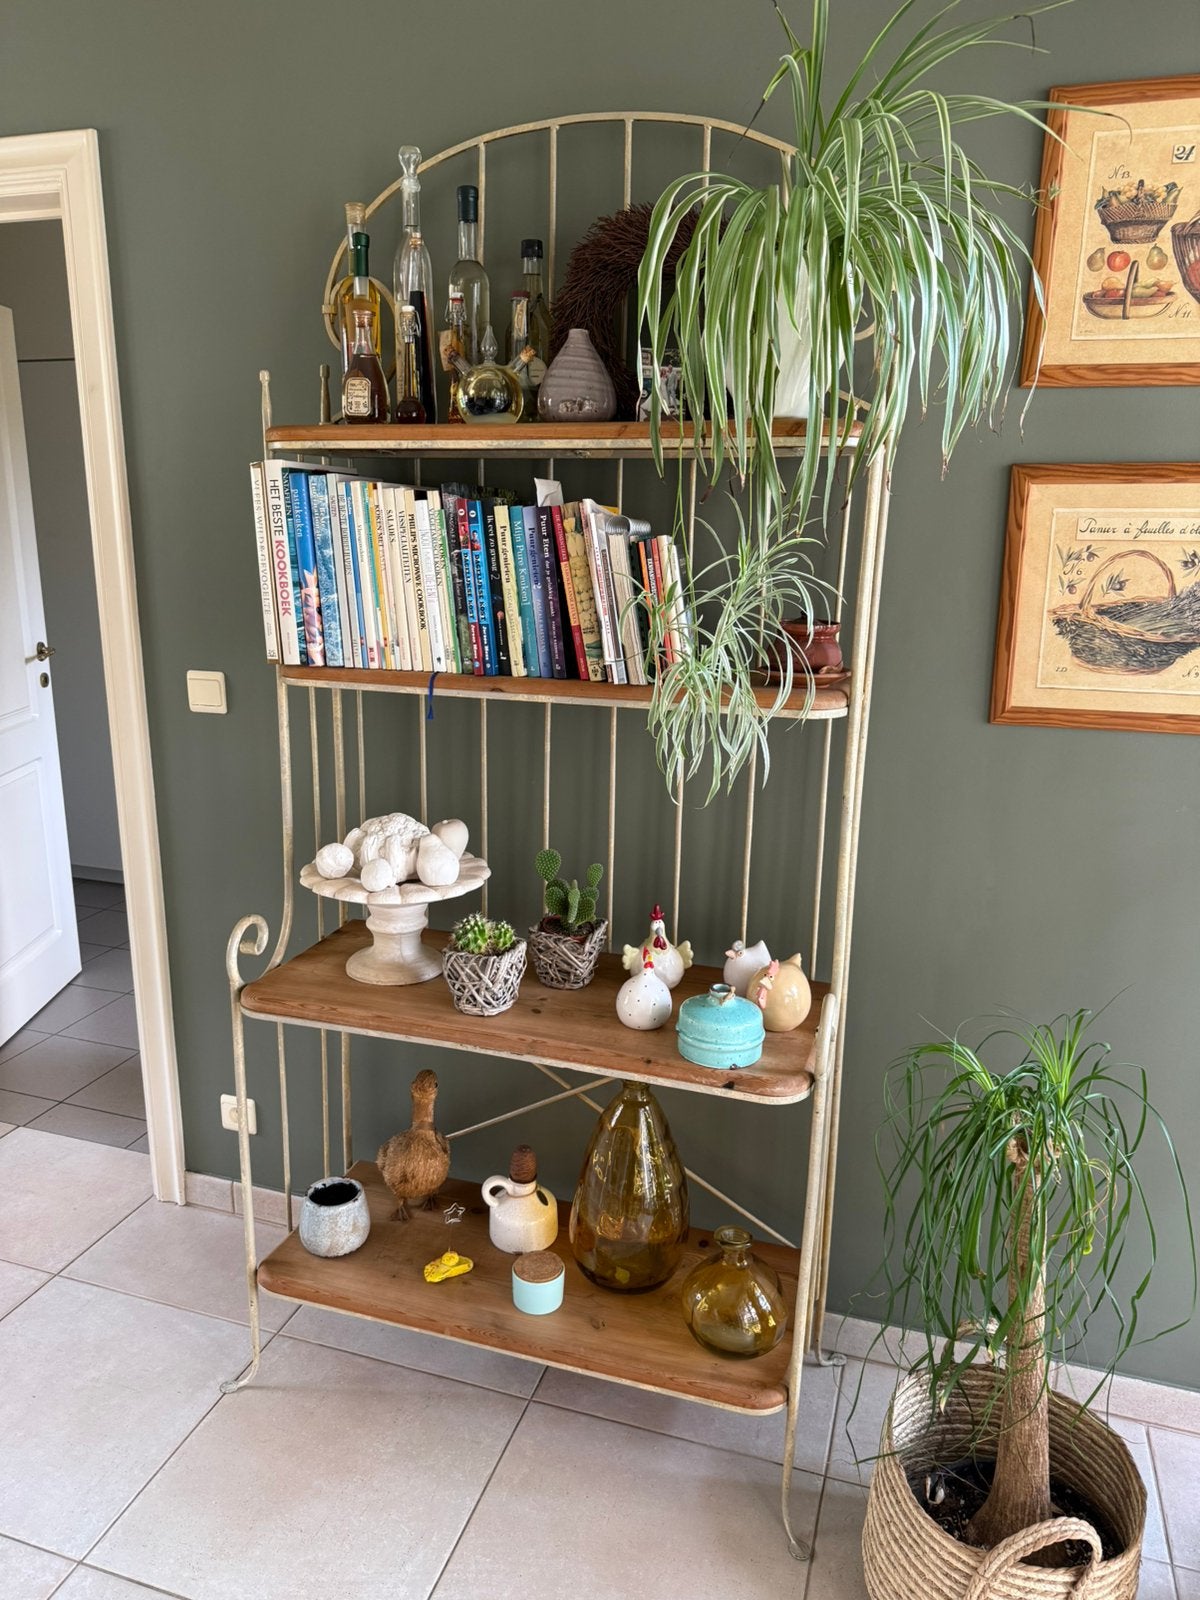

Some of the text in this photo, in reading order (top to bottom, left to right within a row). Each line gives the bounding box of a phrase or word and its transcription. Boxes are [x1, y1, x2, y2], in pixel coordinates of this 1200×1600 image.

[1174, 145, 1196, 161] 21
[269, 479, 280, 501] HET
[271, 504, 283, 537] BESTE
[291, 489, 303, 538] pastakeuken
[374, 504, 382, 531] KOKEN
[487, 515, 493, 524] Ik
[1079, 517, 1117, 533] Panier
[386, 510, 395, 544] SALADES
[513, 520, 523, 544] Mijn
[489, 538, 494, 547] zo
[500, 526, 511, 584] Puur genieten
[542, 538, 550, 559] Eten
[516, 545, 525, 566] Pure
[274, 540, 292, 617] KOOKBOEK
[408, 514, 426, 631] PHILIPS MICROWAVE COOKBOOK
[434, 561, 442, 587] KOKEN
